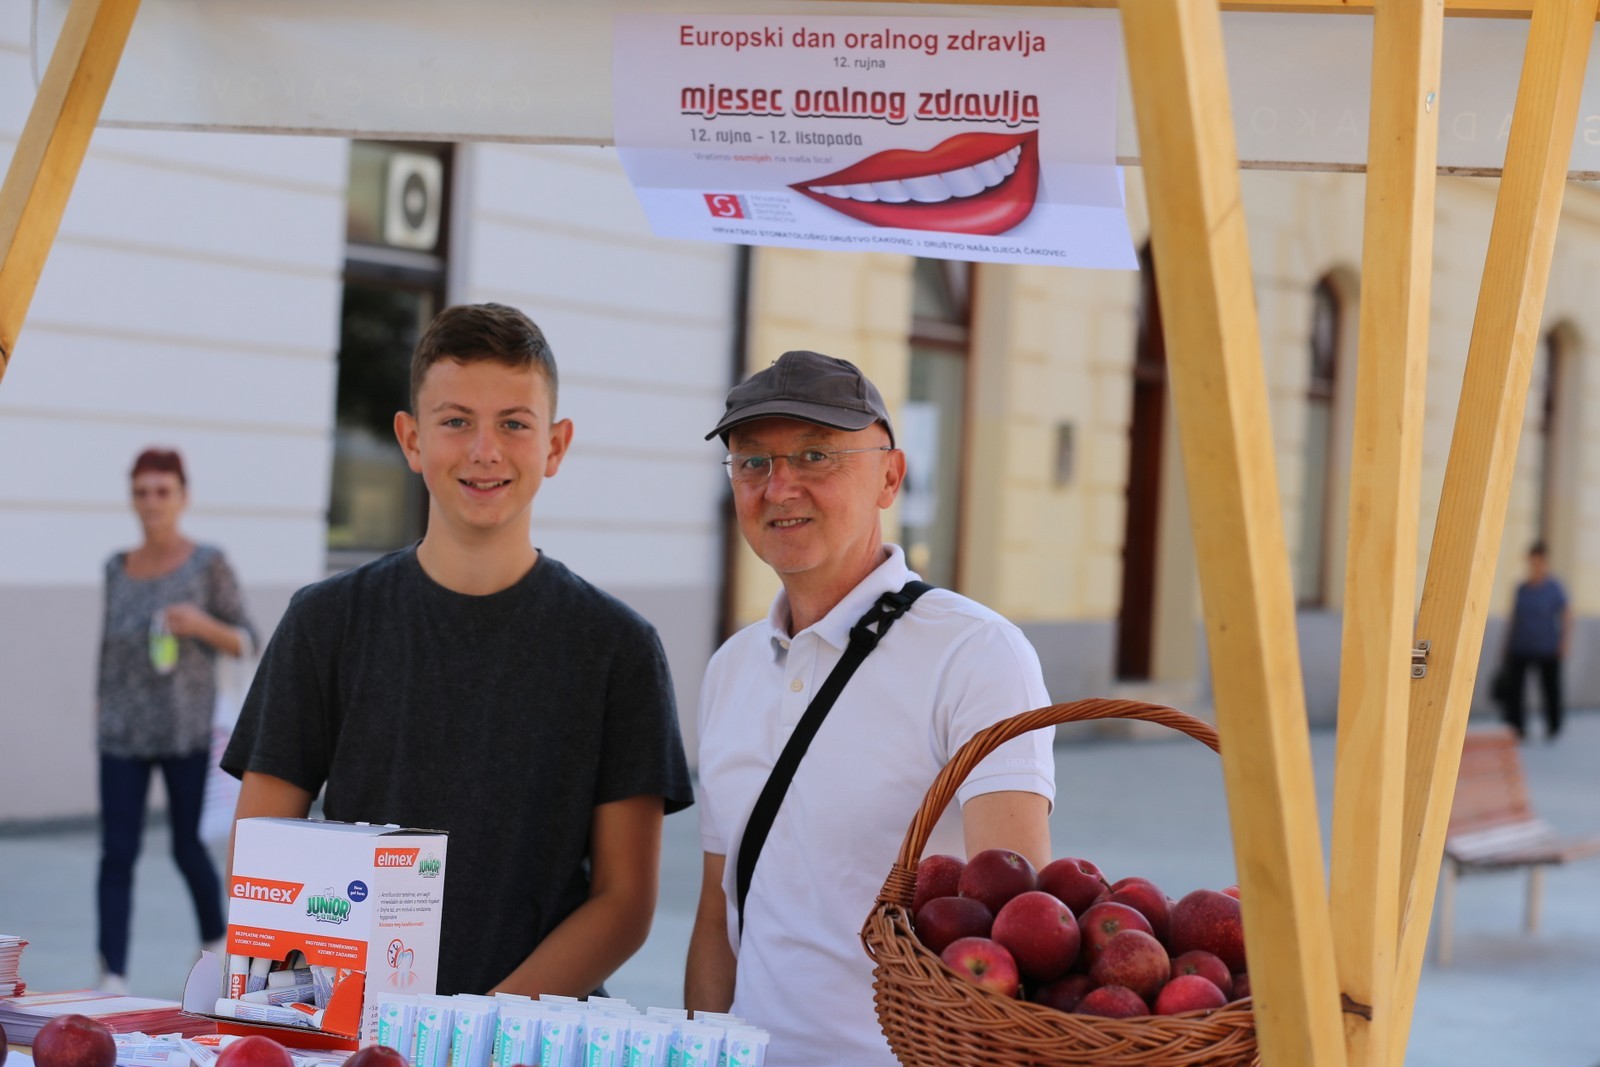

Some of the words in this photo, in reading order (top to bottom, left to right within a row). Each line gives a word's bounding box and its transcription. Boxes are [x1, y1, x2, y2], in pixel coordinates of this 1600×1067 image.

[680, 25, 783, 51] Europski
[792, 27, 835, 48] dan
[844, 28, 938, 55] oralnog
[947, 30, 1046, 57] zdravlja
[833, 57, 850, 68] 12.
[854, 57, 886, 70] rujna
[681, 84, 783, 115] mjesec
[795, 87, 906, 120] oralnog
[918, 89, 1040, 122] zdravlja
[691, 129, 711, 142] 12.
[716, 130, 752, 144] rujna
[770, 131, 791, 144] 12.
[796, 132, 863, 147] listopada
[377, 852, 413, 867] elmex
[233, 882, 293, 903] elmex
